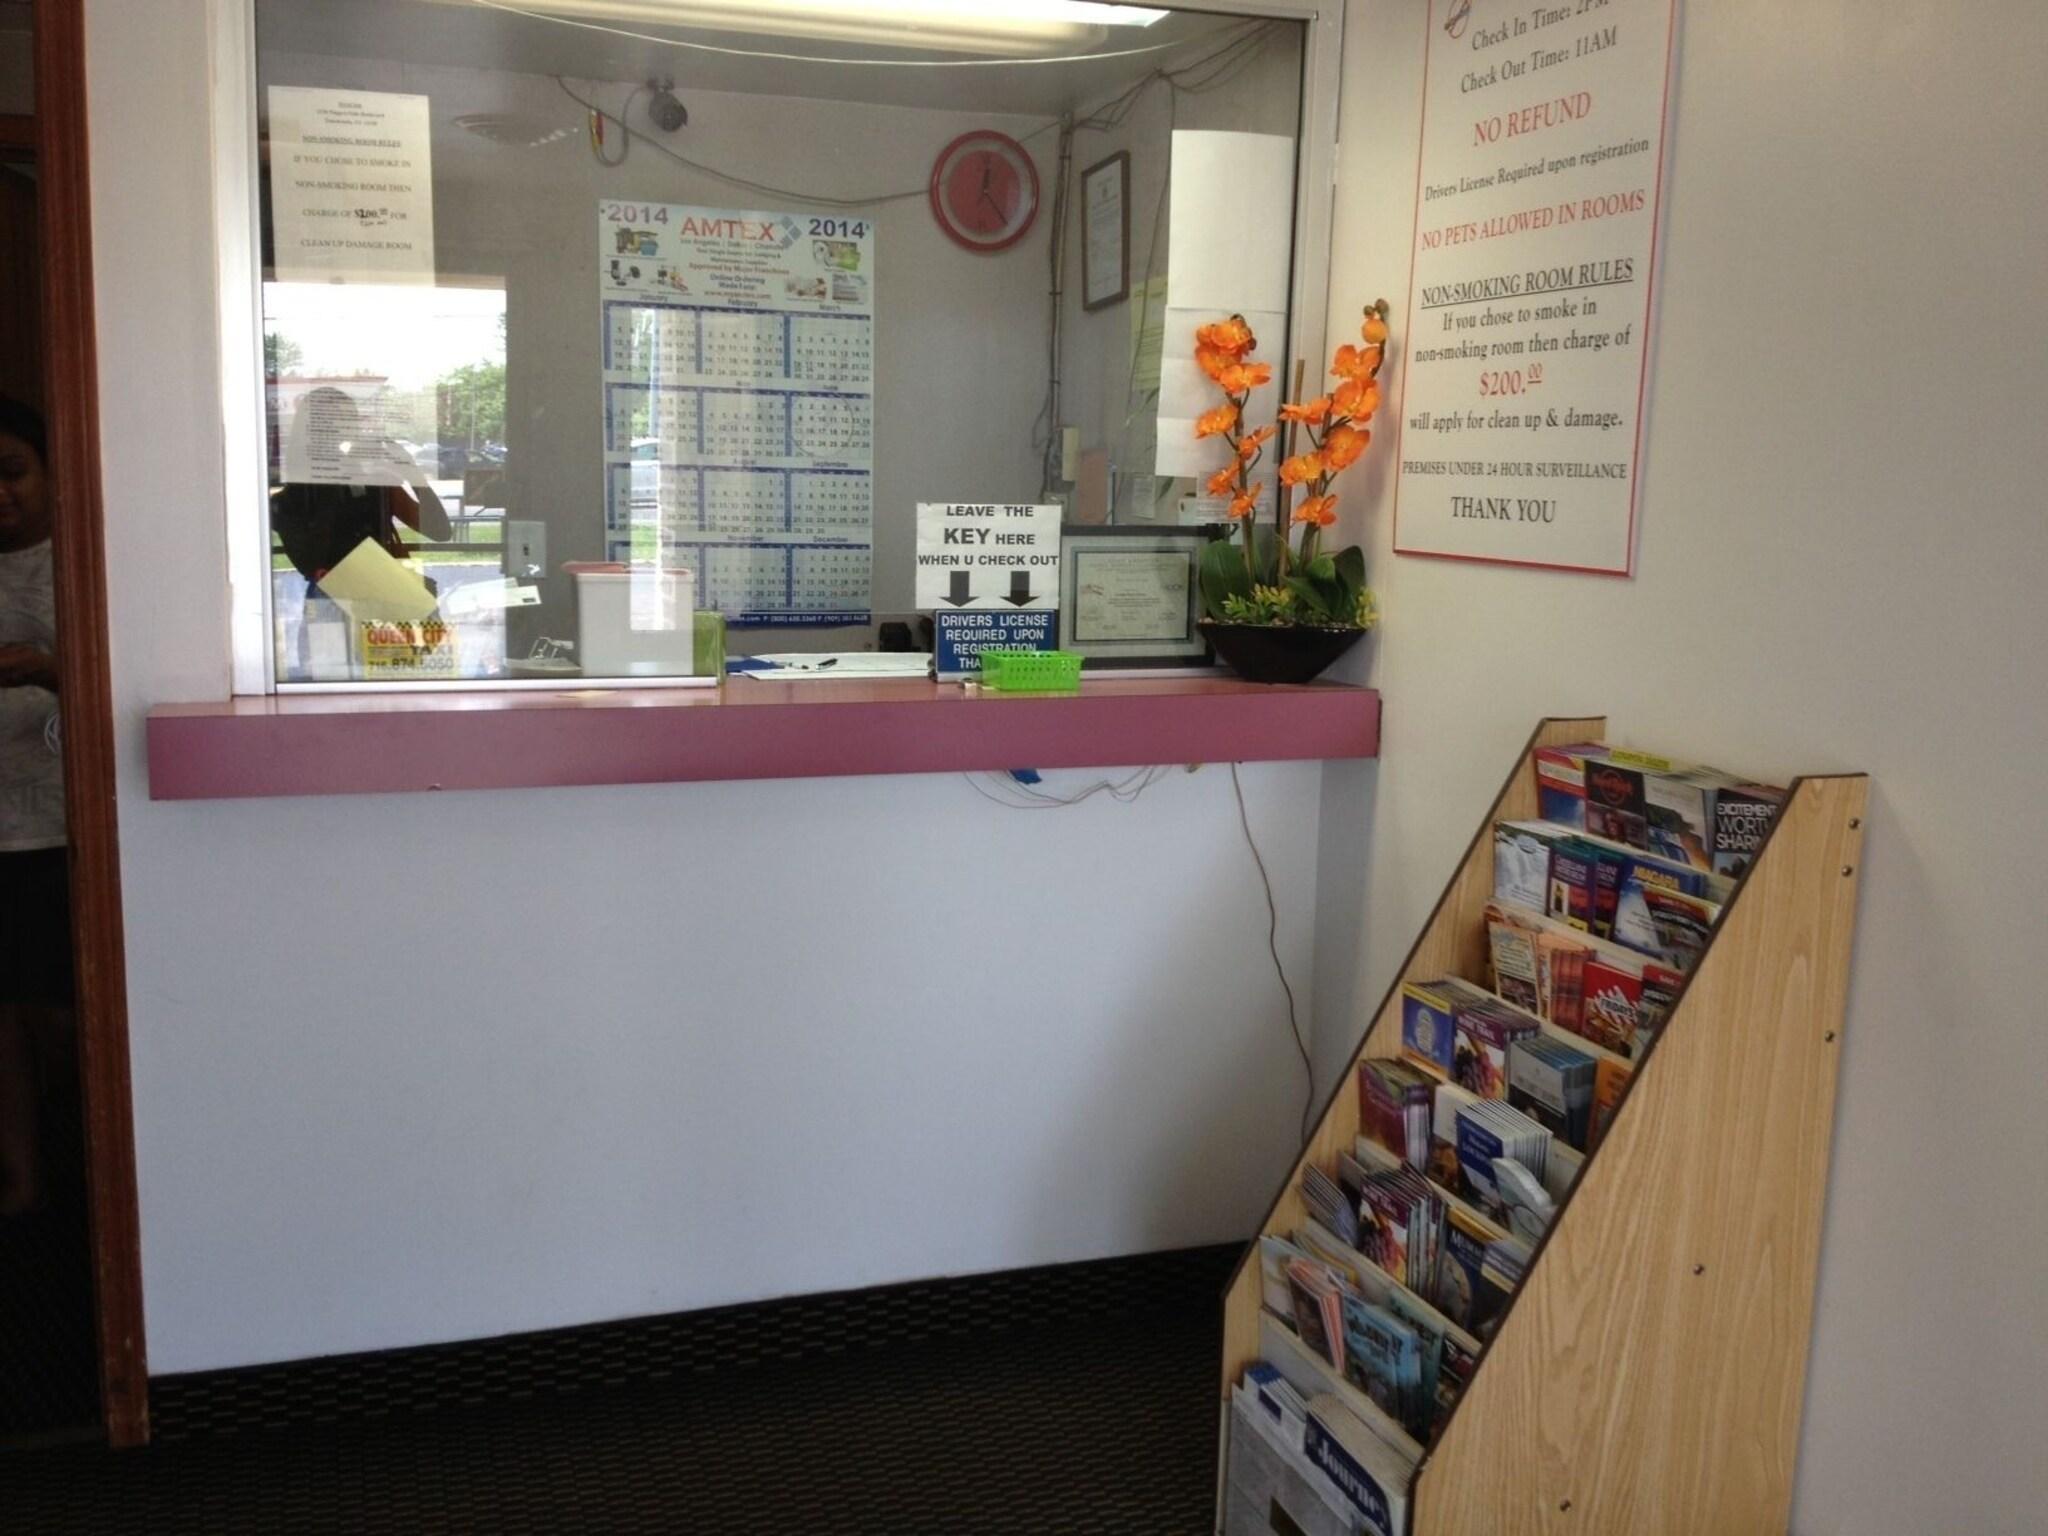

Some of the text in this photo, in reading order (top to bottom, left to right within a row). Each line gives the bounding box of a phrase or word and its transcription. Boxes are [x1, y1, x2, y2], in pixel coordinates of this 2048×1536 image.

[1471, 20, 1509, 51] Check
[1513, 17, 1528, 37] In
[1532, 5, 1571, 31] Time:
[1461, 24, 1618, 94] Check Out Time: 11AM
[1473, 91, 1592, 146] NO REFUND
[303, 155, 322, 164] YOU
[1425, 138, 1649, 201] Drivers License Required upon registration
[608, 204, 865, 241] 2014 AMTEX 2014
[1421, 189, 1646, 250] NO PETS ALLOWED IN ROOMS
[345, 240, 385, 249] DAMAGE
[1421, 258, 1634, 307] NON-SMOKING ROOM RULES
[728, 298, 758, 307] February
[819, 303, 841, 311] March
[1443, 296, 1597, 334] If you chose to smoke in
[1415, 323, 1632, 363] non-smoking room then charge of
[1410, 407, 1623, 434] will apply for clean up & damage.
[1402, 460, 1627, 480] PREMISES UNDER 24 HOUR SURVEILLANCE
[946, 505, 1034, 518] LEAVE THE
[1451, 496, 1557, 524] THANK YOU
[813, 535, 848, 543] December
[944, 528, 1035, 545] KEY HERE
[918, 555, 1059, 566] WHEN U CHECK OUT
[941, 614, 1049, 627] DRIVERS LICENSE
[945, 629, 1044, 641] REQUIRED UPON
[953, 643, 1037, 655] REGISTRATION
[959, 657, 982, 669] THA
